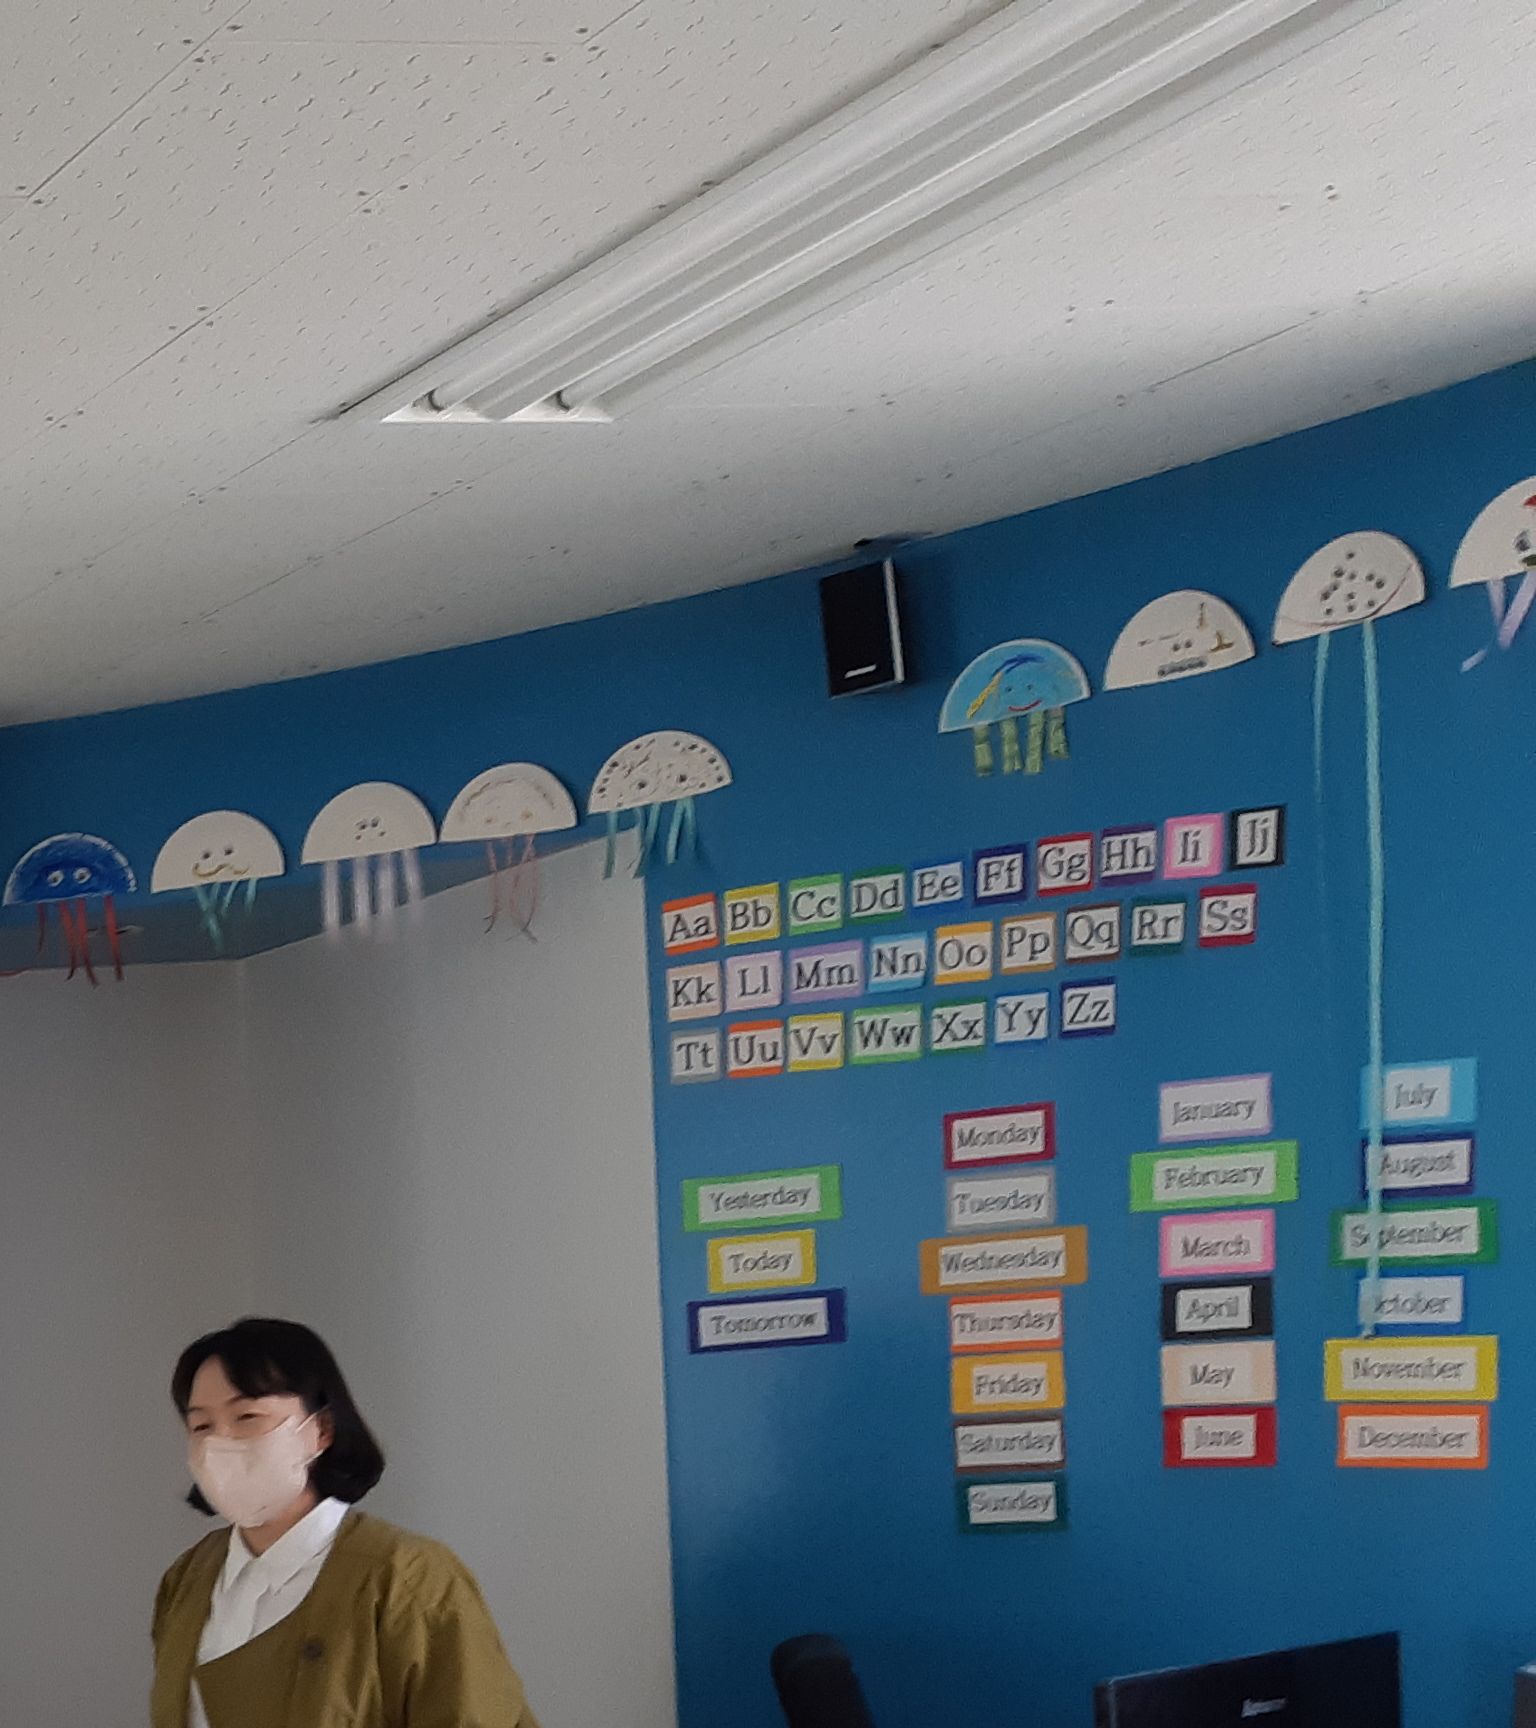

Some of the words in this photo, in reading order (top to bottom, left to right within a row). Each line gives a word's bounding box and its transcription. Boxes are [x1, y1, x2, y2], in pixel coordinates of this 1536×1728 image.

[668, 911, 711, 942] Aa
[729, 901, 773, 931] Bb
[791, 890, 837, 921] Cc
[852, 879, 902, 913] Dd
[915, 870, 960, 901] Ee
[983, 859, 1018, 892] Ff
[1041, 846, 1087, 881] Gg
[1103, 837, 1154, 872] Hh
[1179, 829, 1202, 864] Ii
[1246, 817, 1270, 857] Jj
[671, 976, 716, 1008] Kk
[737, 964, 771, 996] Ll
[793, 958, 858, 992] Mm
[873, 946, 923, 978] Nn
[938, 938, 987, 970] Oo
[1007, 926, 1050, 960] Pp
[1070, 914, 1119, 950] Qq
[1135, 908, 1180, 940] Rr
[1206, 900, 1248, 932] Ss
[676, 1041, 714, 1071] Tt
[731, 1035, 780, 1066] Uu
[789, 1026, 839, 1056] Vv
[854, 1018, 920, 1049] Ww
[933, 1011, 983, 1043] Xx
[997, 1002, 1046, 1035] Yy
[1067, 992, 1110, 1026] Zz
[1395, 1082, 1439, 1109] July
[1172, 1100, 1256, 1126] January
[957, 1122, 1042, 1148] Monday
[1379, 1150, 1456, 1178] August
[1164, 1165, 1265, 1189] February
[710, 1185, 811, 1212] Yesterday
[955, 1189, 1045, 1214] Tuesday
[1181, 1234, 1251, 1258] March
[729, 1250, 792, 1274] Today
[943, 1246, 1064, 1273] Wednesday
[1185, 1296, 1240, 1324] April
[1369, 1291, 1451, 1315] ctober
[710, 1312, 818, 1334] Tomorrow
[954, 1309, 1059, 1333] Thursday
[1190, 1363, 1235, 1389] May
[1352, 1357, 1467, 1380] November
[975, 1373, 1046, 1396] Friday
[960, 1431, 1058, 1454] Saturday
[1194, 1425, 1245, 1450] June
[1358, 1426, 1470, 1449] December
[972, 1489, 1054, 1512] Sunday
